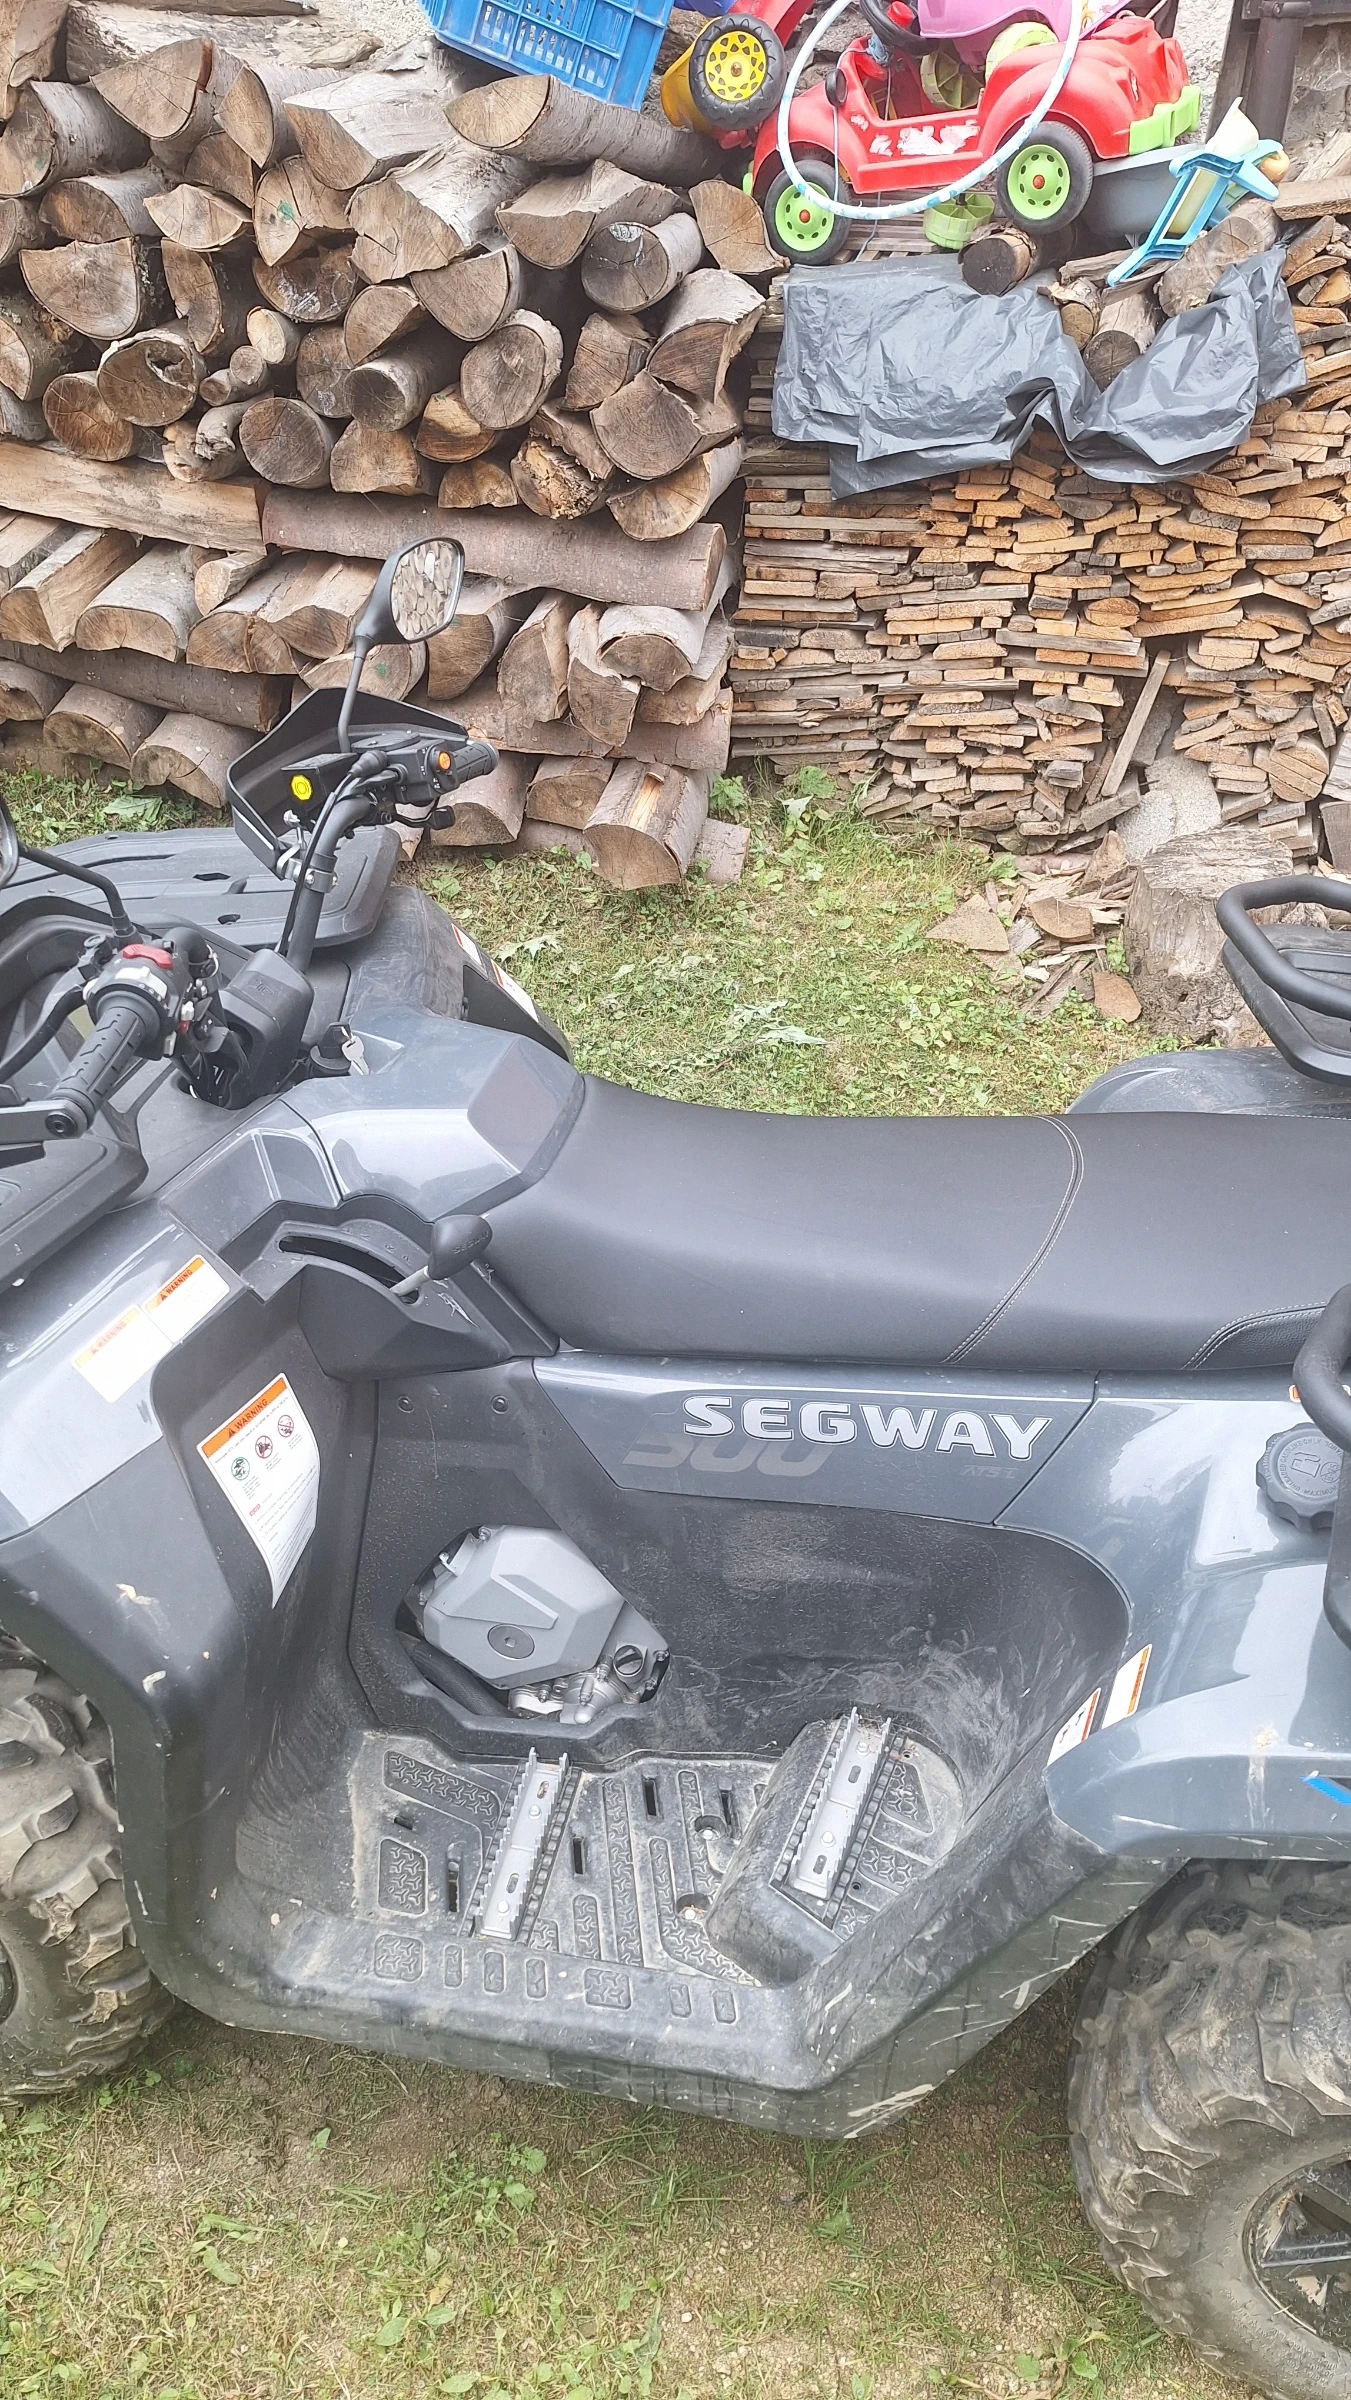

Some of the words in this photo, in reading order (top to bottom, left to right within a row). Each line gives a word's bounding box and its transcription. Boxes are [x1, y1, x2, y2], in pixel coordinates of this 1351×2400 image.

[165, 1268, 194, 1296] WARNING
[234, 1398, 269, 1431] WARNING
[683, 1394, 1053, 1461] SEGWAY
